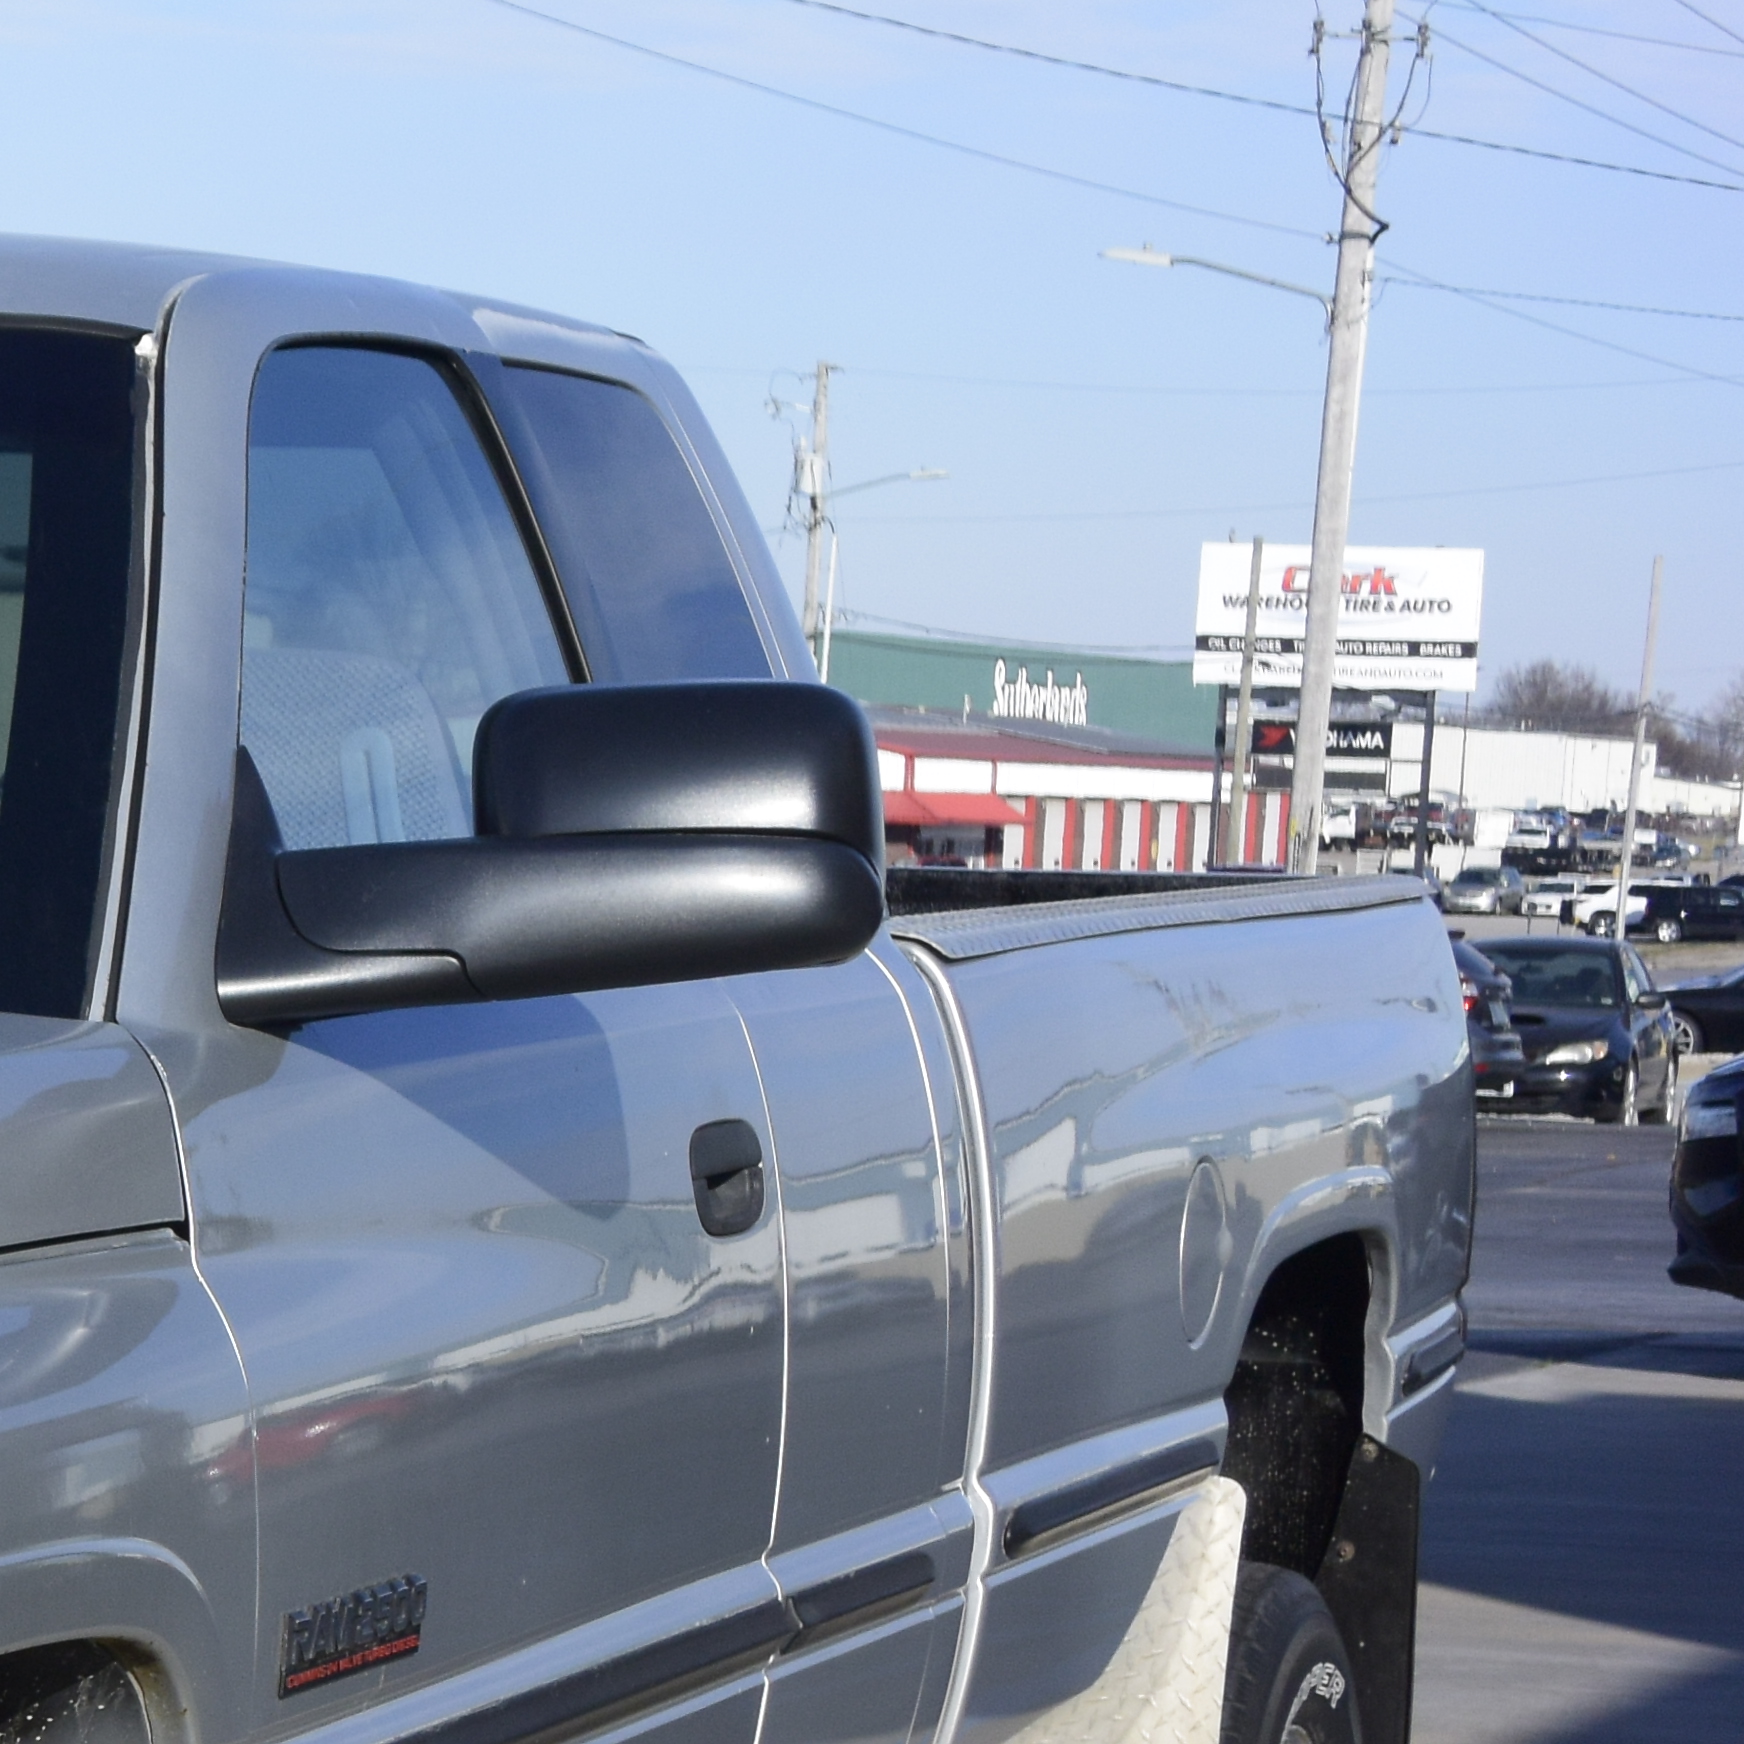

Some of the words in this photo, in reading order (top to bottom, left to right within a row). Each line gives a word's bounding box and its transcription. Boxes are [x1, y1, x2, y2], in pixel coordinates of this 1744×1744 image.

[1282, 566, 1399, 596] Crk
[1343, 598, 1382, 613] TIRE
[1384, 600, 1395, 613] &
[1399, 598, 1453, 614] AUTO
[1229, 637, 1282, 653] CHNGES
[1365, 642, 1409, 657] REPAIRS
[1419, 643, 1462, 657] BRAKES
